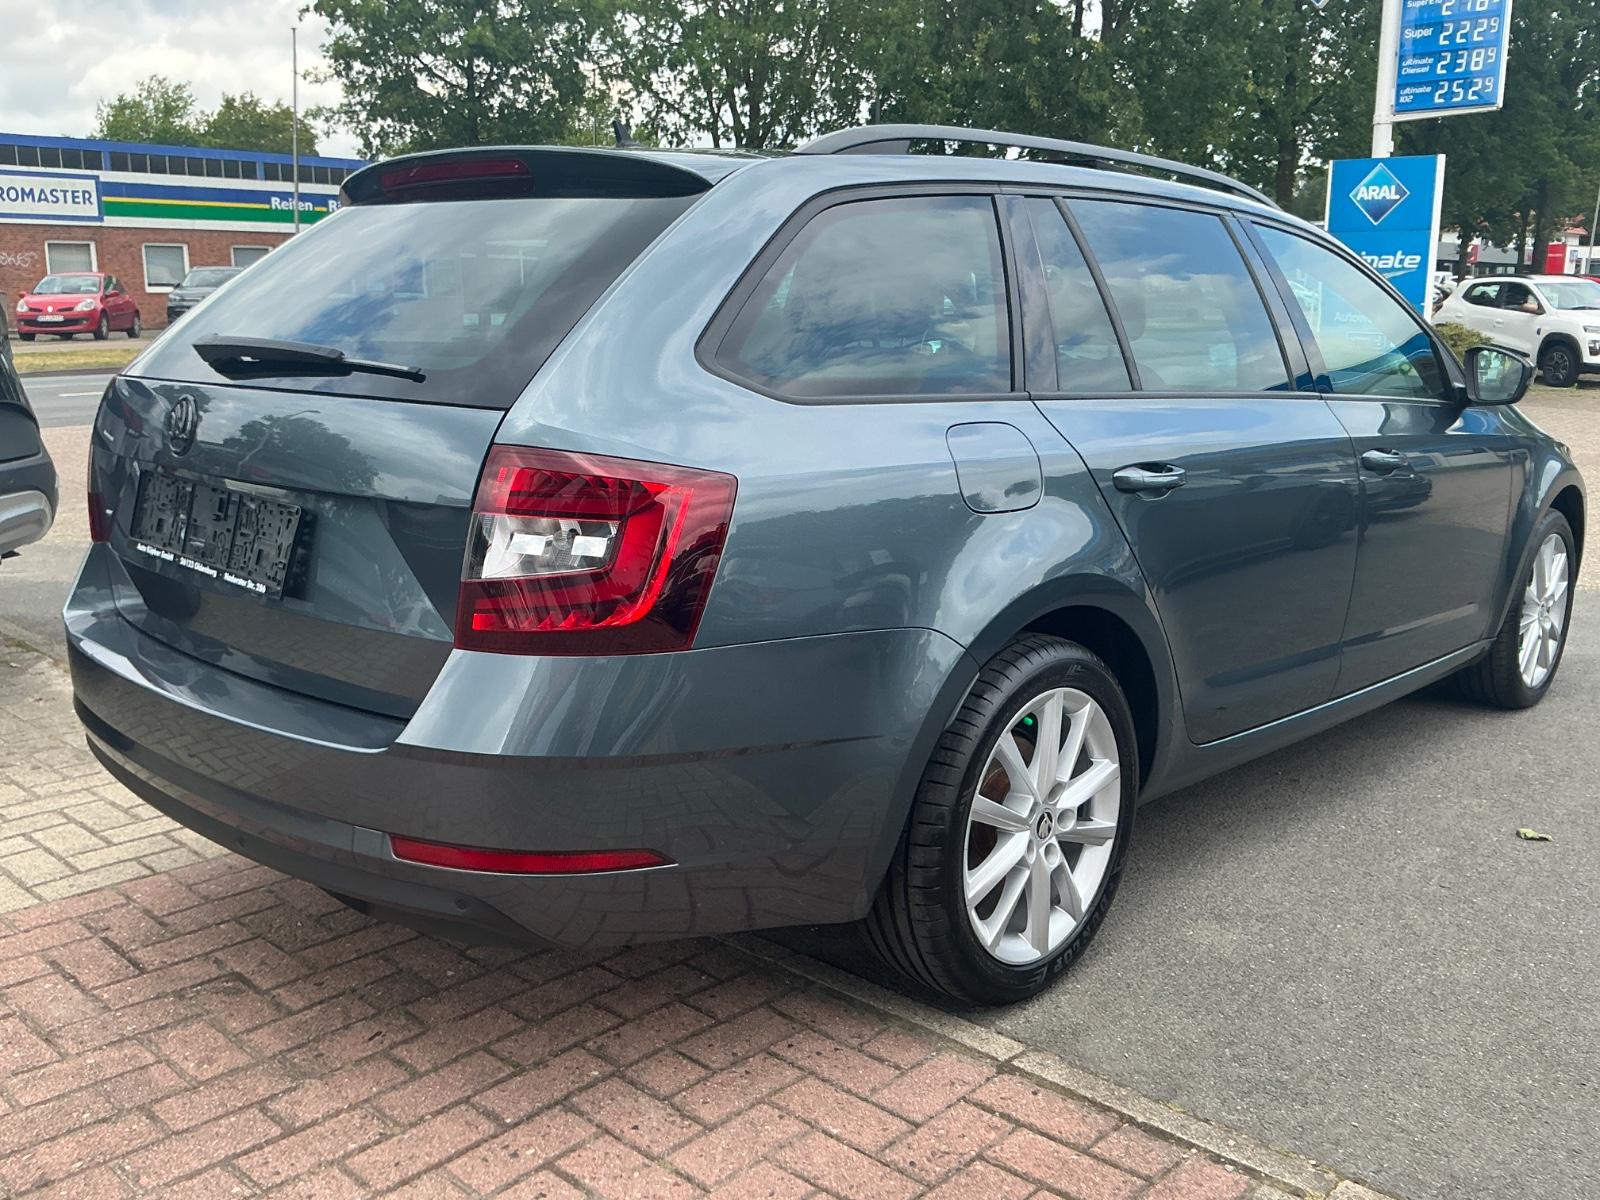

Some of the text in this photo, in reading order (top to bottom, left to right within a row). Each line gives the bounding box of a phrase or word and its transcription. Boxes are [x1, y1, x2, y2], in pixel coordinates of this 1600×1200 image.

[1404, 28, 1434, 39] Super
[1402, 57, 1434, 66] ultimate
[1401, 66, 1430, 75] Diesel
[1400, 86, 1432, 95] ultimate
[1357, 185, 1400, 201] ARAL
